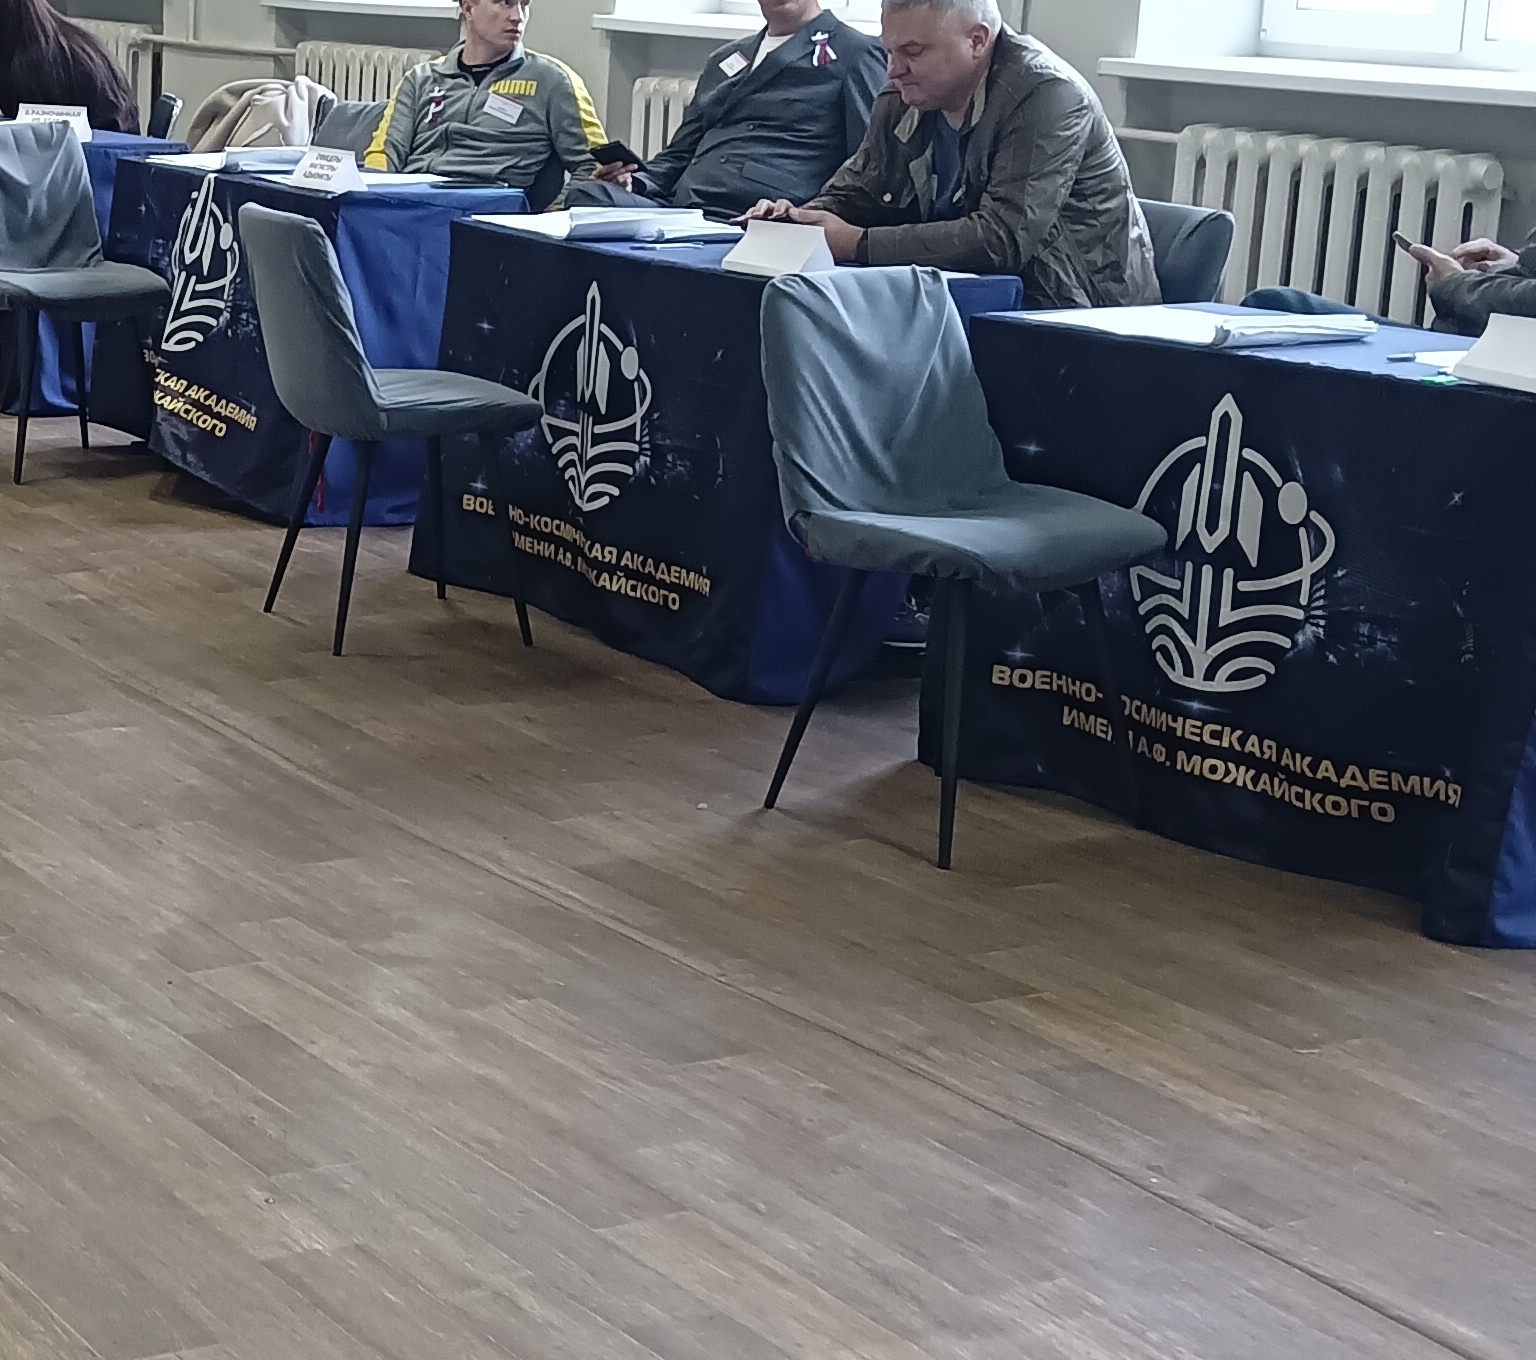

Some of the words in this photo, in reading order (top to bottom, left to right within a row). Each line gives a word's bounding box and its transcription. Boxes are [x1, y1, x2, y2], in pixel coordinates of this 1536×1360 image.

[488, 79, 538, 96] PUMA
[185, 384, 258, 432] АКАДЕМИЯ
[512, 530, 555, 559] МЕНИ
[619, 550, 711, 597] АКАДЕМИЯ
[1175, 750, 1396, 824] МОЖАЙСКОГО
[1280, 747, 1462, 808] АКАДЕМИЯ
